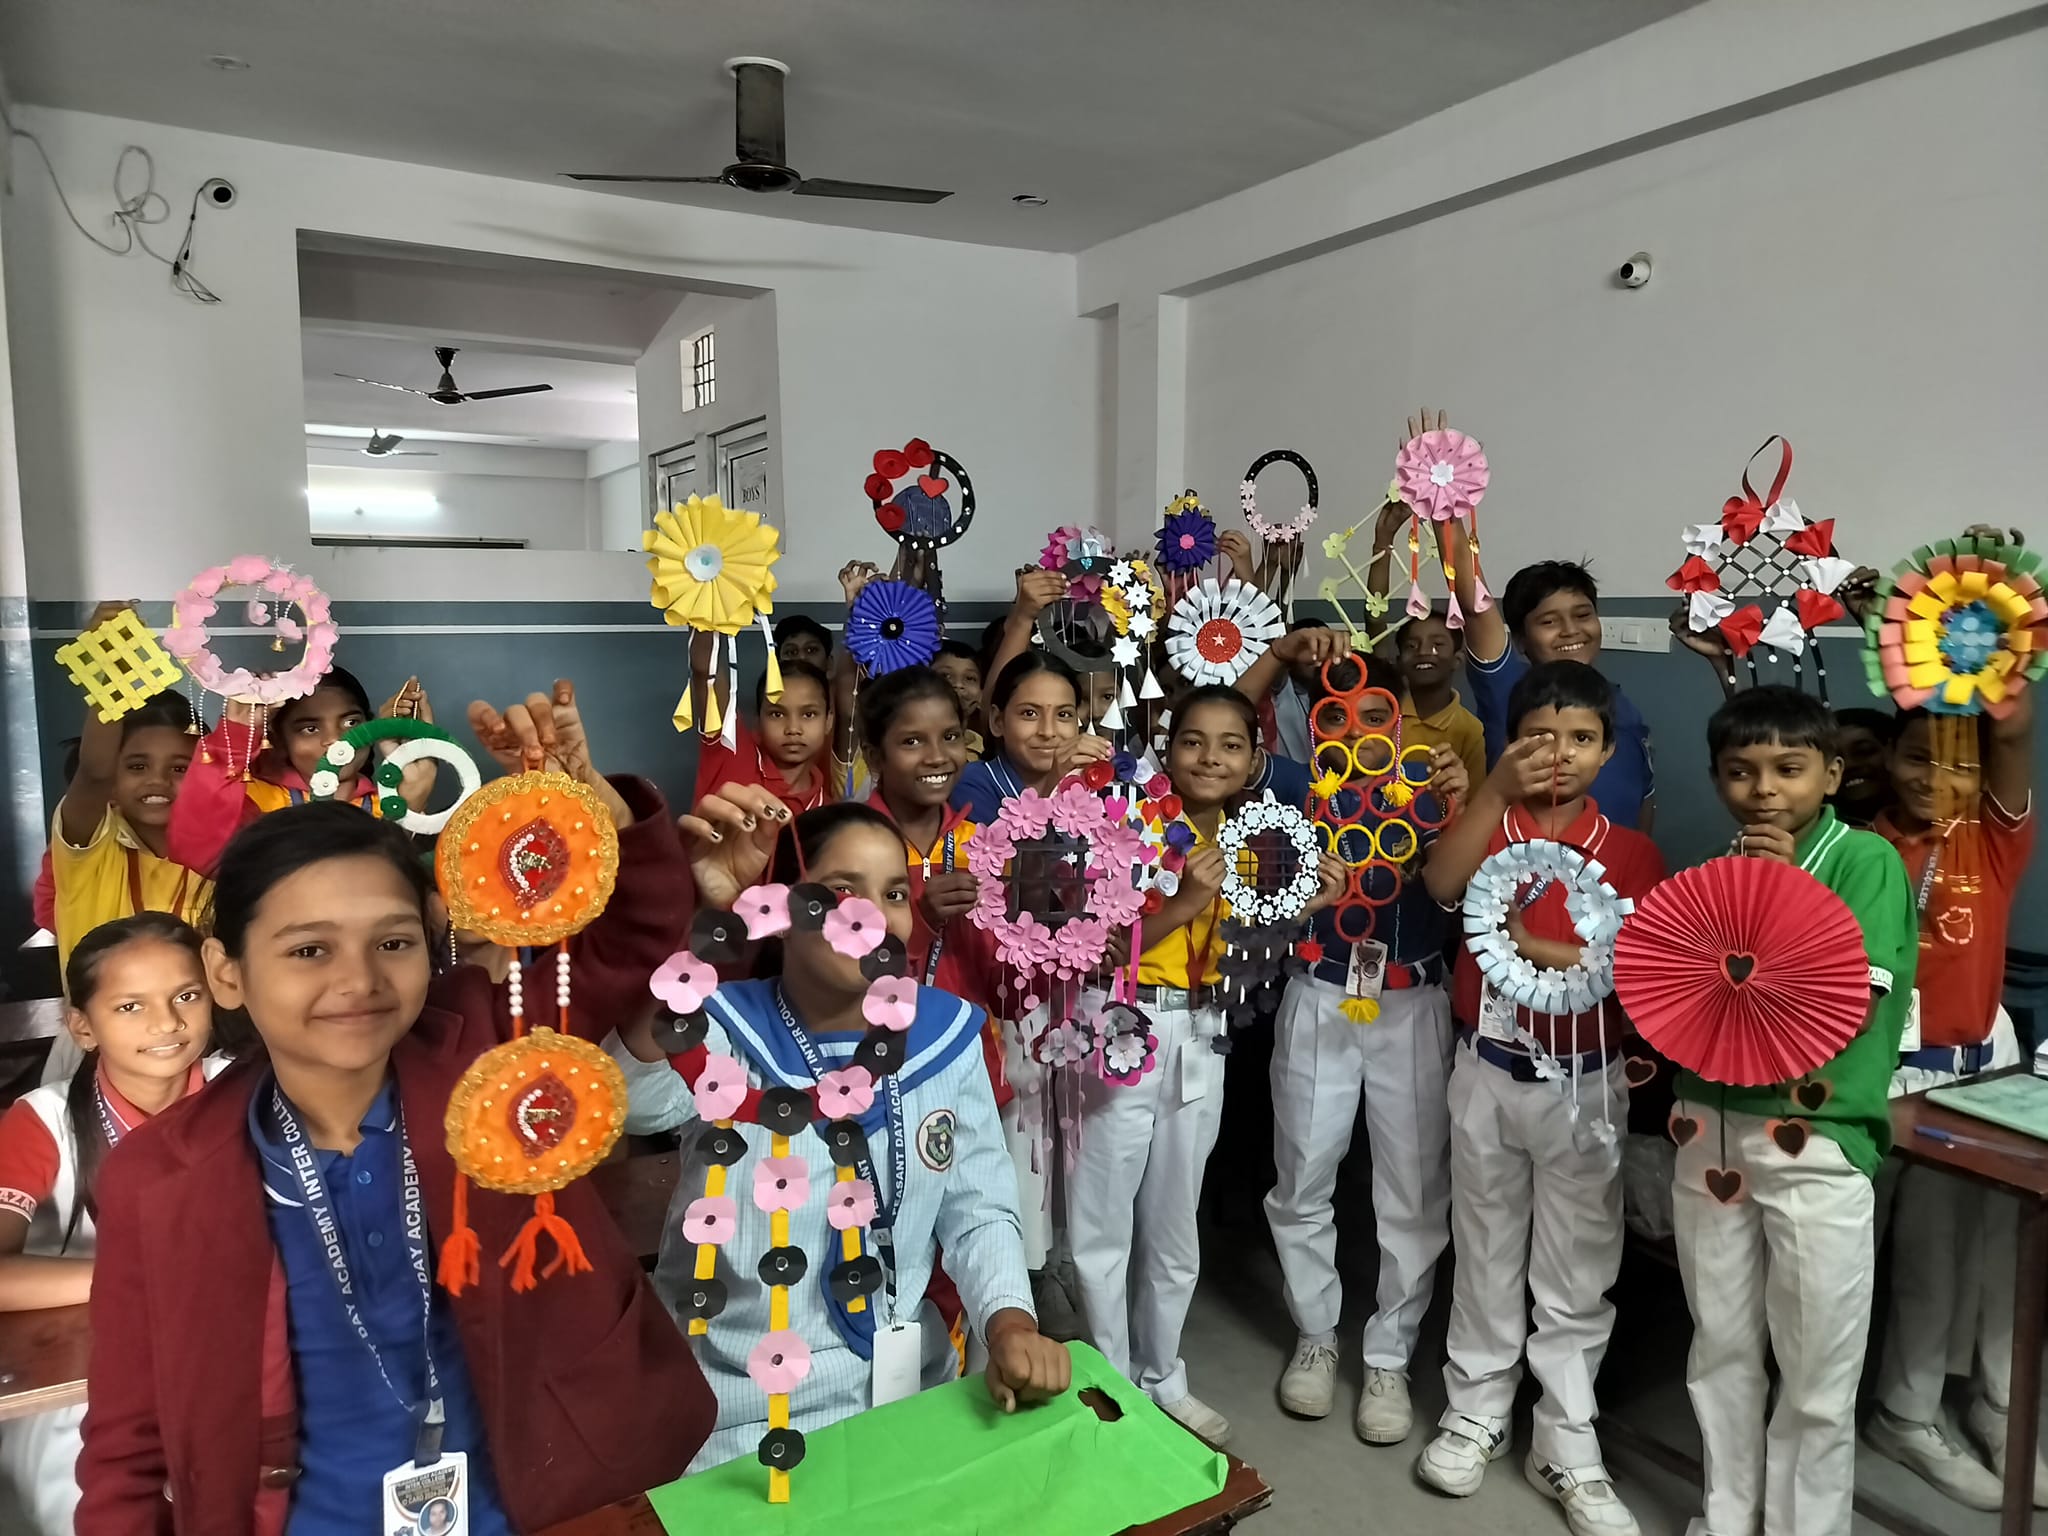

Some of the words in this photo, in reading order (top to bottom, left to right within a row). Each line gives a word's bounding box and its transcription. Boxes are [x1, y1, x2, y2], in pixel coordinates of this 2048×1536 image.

[742, 485, 760, 503] BOYS
[1917, 870, 1934, 911] COLLEGE
[931, 937, 943, 967] PEAS
[791, 1026, 818, 1065] INTER
[888, 1073, 902, 1115] ACADE
[891, 1120, 905, 1148] DAY
[291, 1143, 324, 1201] INTER
[402, 1147, 423, 1240] ACADEMY
[311, 1206, 353, 1295] ACADEMY
[409, 1247, 429, 1284] DAY
[345, 1303, 369, 1339] DAY
